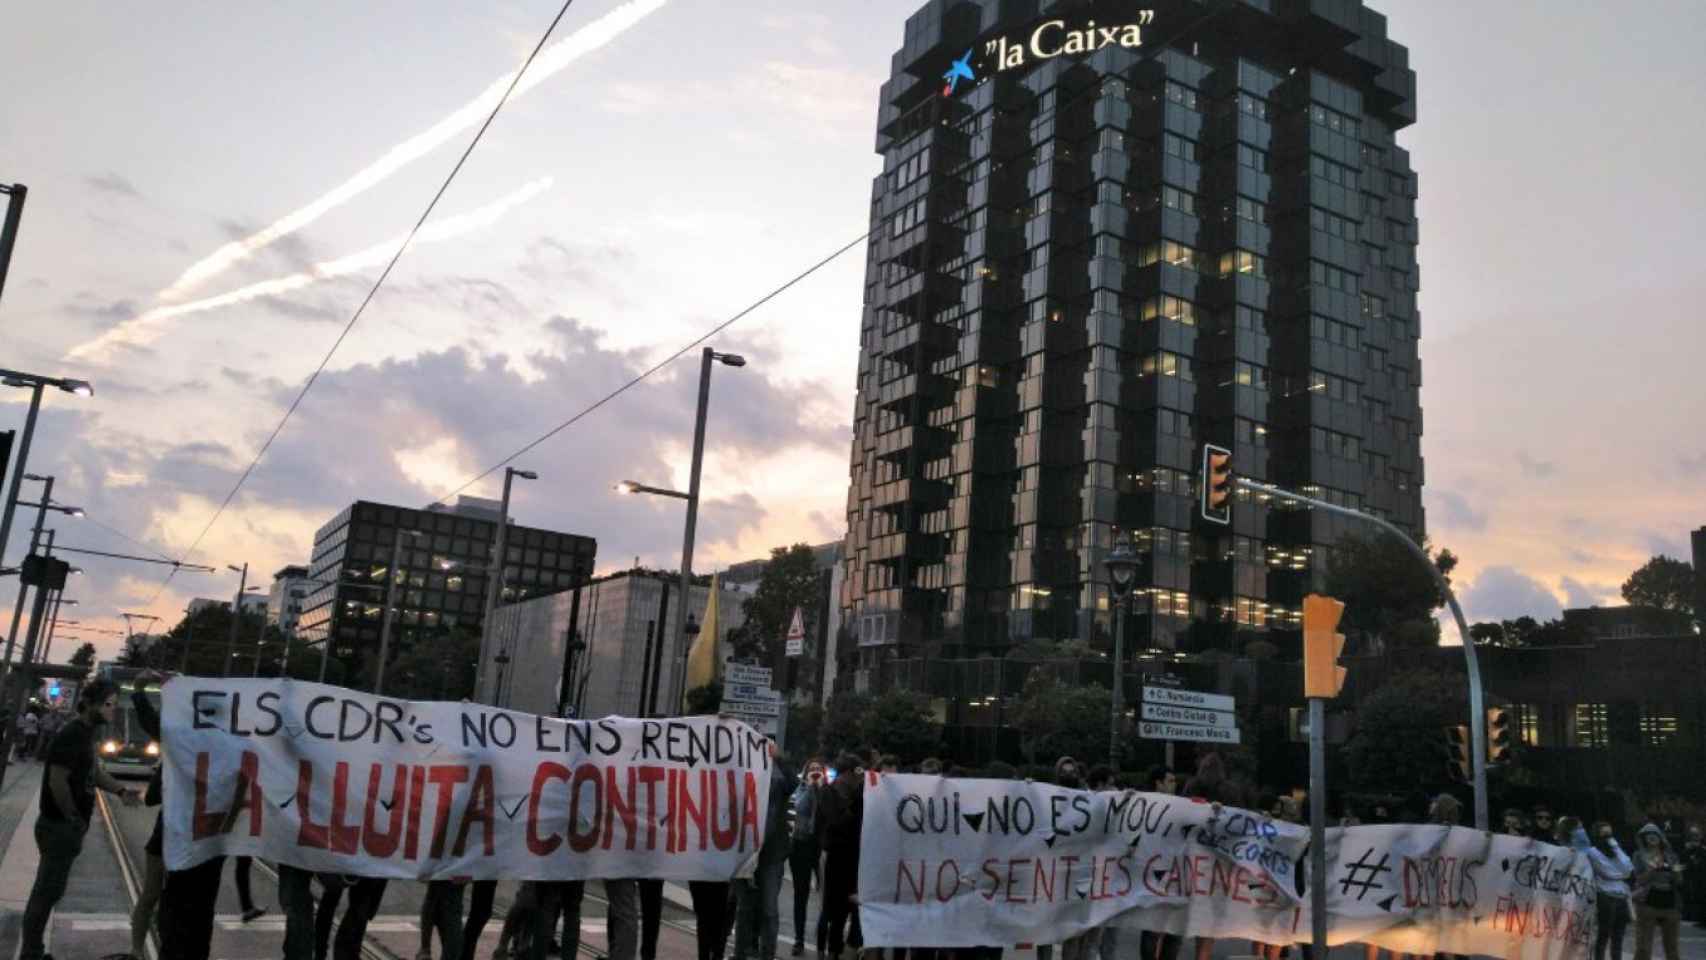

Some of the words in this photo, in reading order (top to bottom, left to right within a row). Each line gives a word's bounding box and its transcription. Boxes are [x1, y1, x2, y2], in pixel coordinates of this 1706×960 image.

[193, 691, 283, 737] ELS
[305, 696, 434, 744] CDR's
[461, 712, 517, 748] NO
[536, 716, 622, 755] ENS
[193, 750, 263, 841] LA
[297, 758, 494, 859] LLUITA
[526, 761, 760, 857] CONTINUA
[987, 795, 1034, 836] NO
[1051, 795, 1090, 836] ES
[895, 859, 960, 904] NO
[981, 855, 1080, 904] SENT
[1089, 855, 1132, 900] LES
